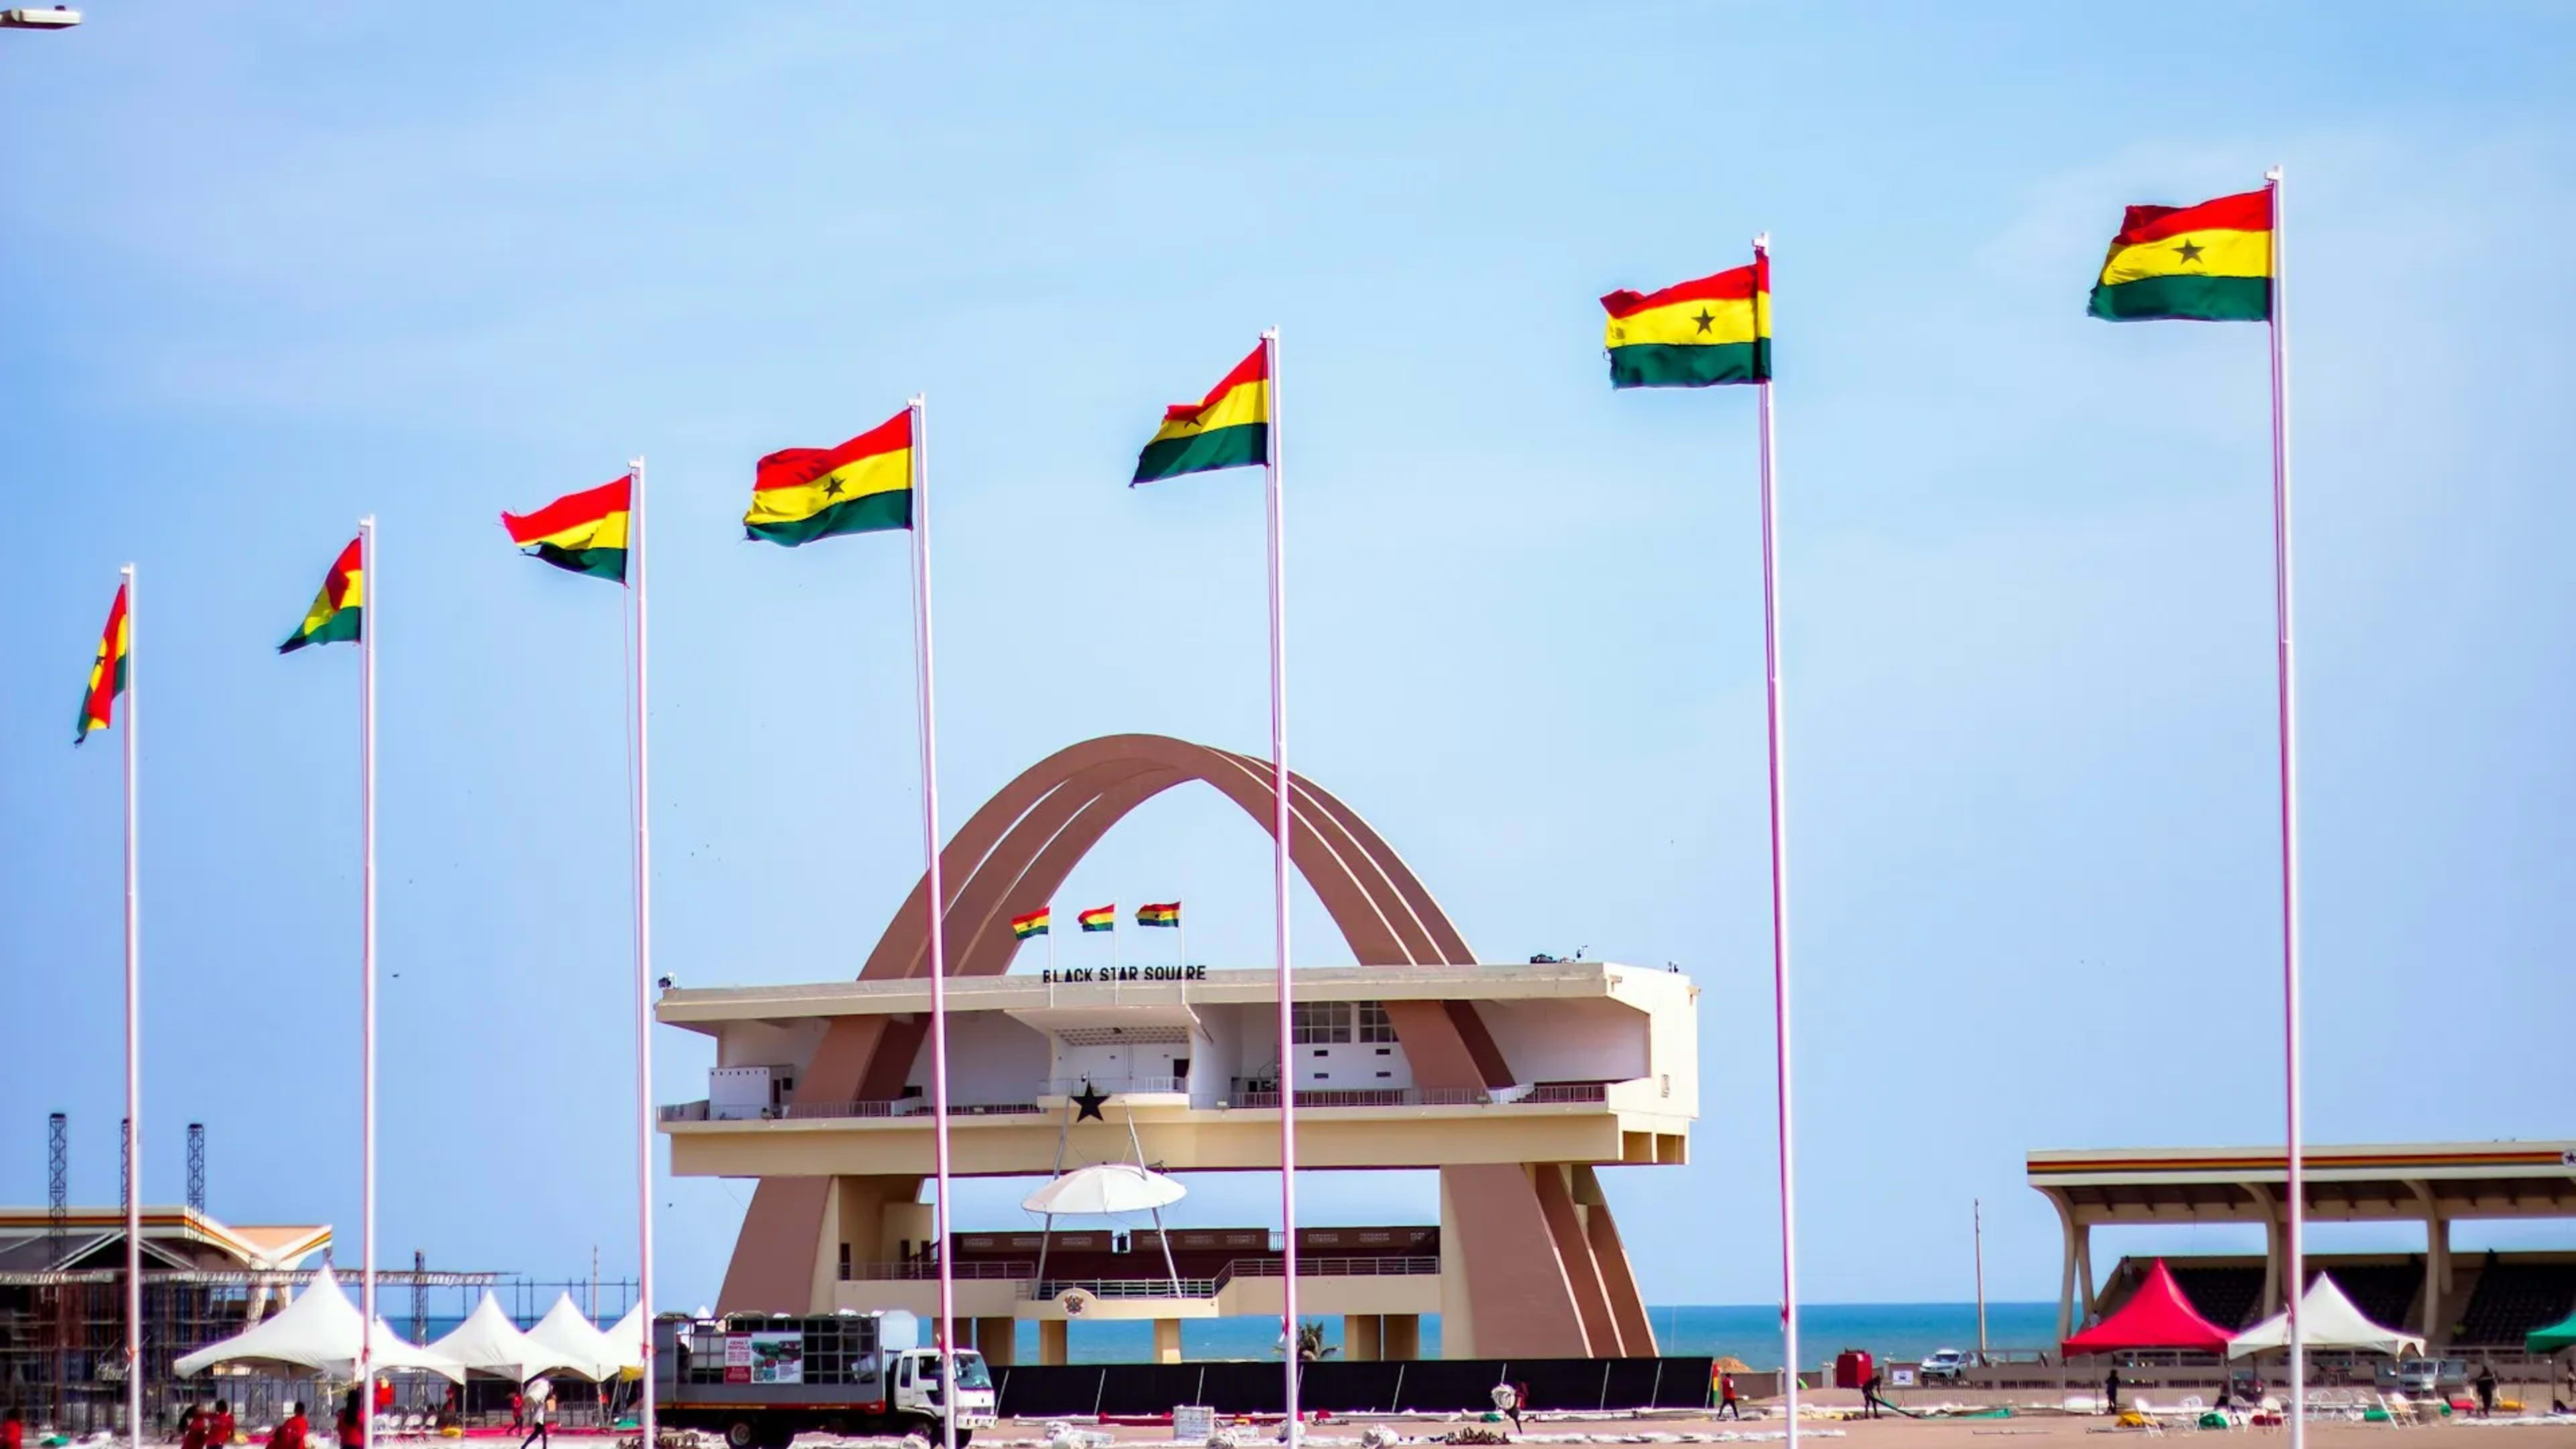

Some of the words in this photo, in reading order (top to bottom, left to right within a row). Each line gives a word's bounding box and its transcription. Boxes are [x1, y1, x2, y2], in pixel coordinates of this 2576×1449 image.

[1042, 969, 1093, 983] BLACK
[1099, 967, 1138, 981] STAR
[1144, 965, 1207, 980] SQUARE
